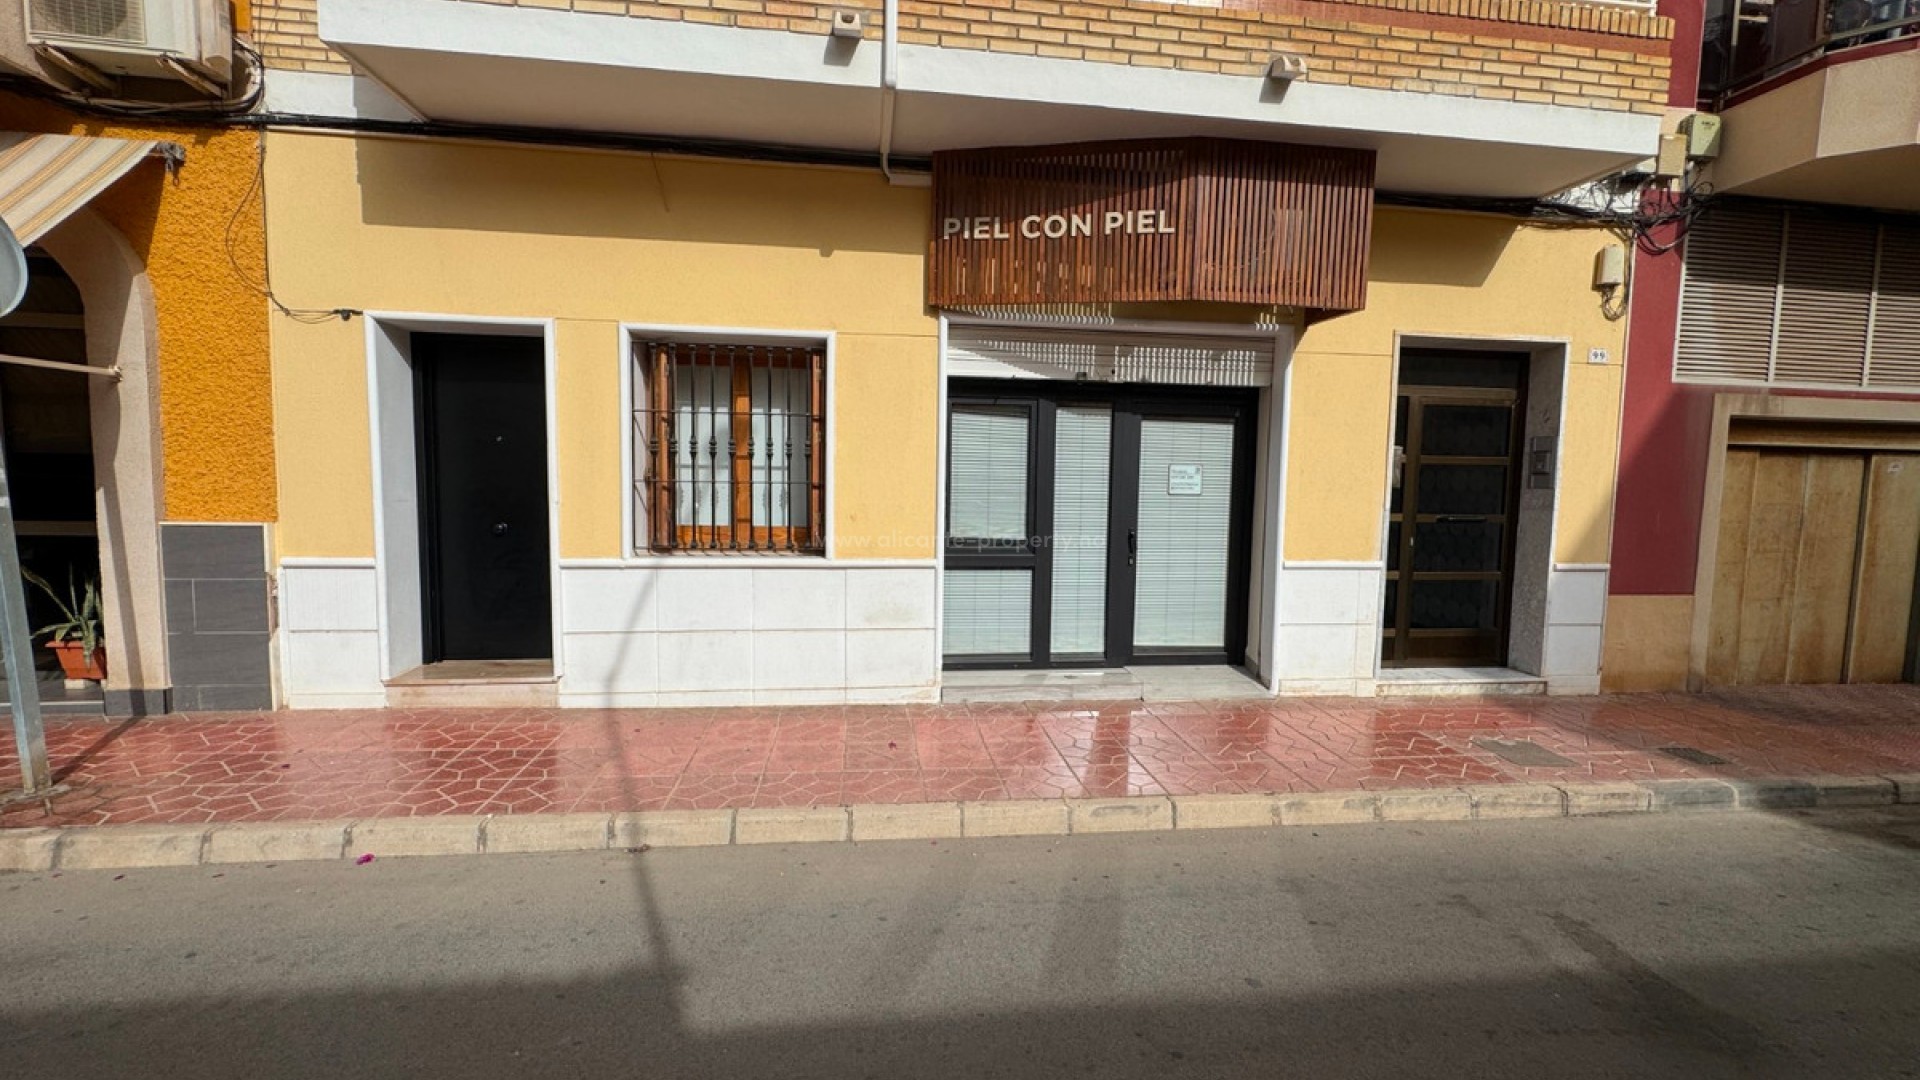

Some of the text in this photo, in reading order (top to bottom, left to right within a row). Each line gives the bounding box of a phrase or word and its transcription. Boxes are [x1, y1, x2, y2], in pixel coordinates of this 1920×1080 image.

[944, 210, 1175, 239] PIEL CON PIEL
